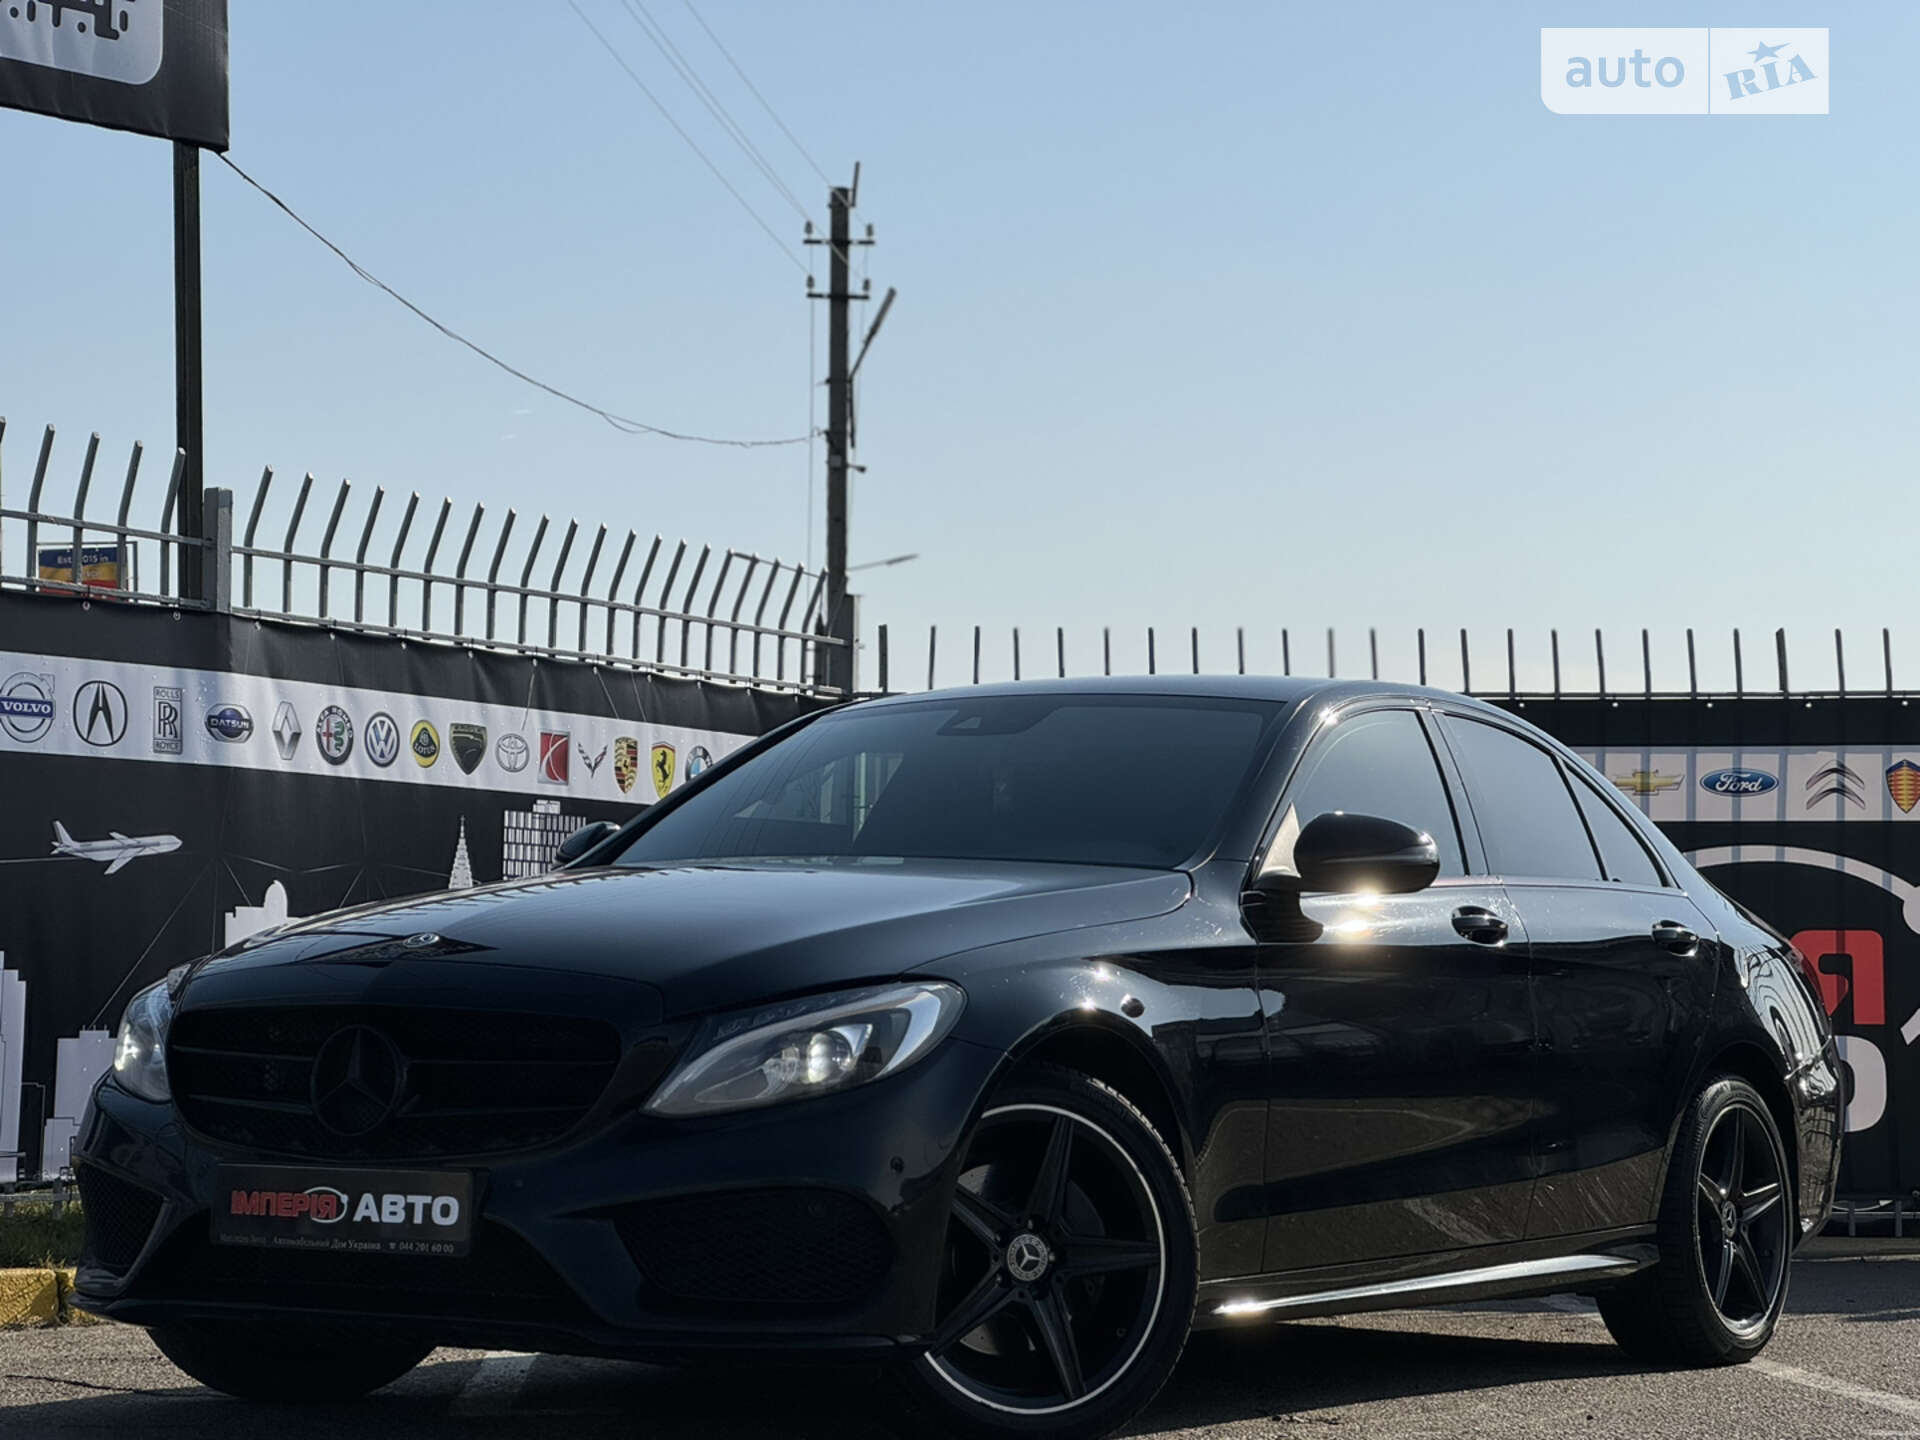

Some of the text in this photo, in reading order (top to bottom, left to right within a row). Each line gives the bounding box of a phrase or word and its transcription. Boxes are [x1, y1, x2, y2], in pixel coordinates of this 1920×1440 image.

[155, 688, 181, 699] ROLLS
[3, 700, 51, 715] VOLVO
[210, 717, 249, 729] DATSUN
[414, 743, 436, 754] LOTUS
[1715, 770, 1762, 793] Ford
[353, 1193, 460, 1226] АВТО
